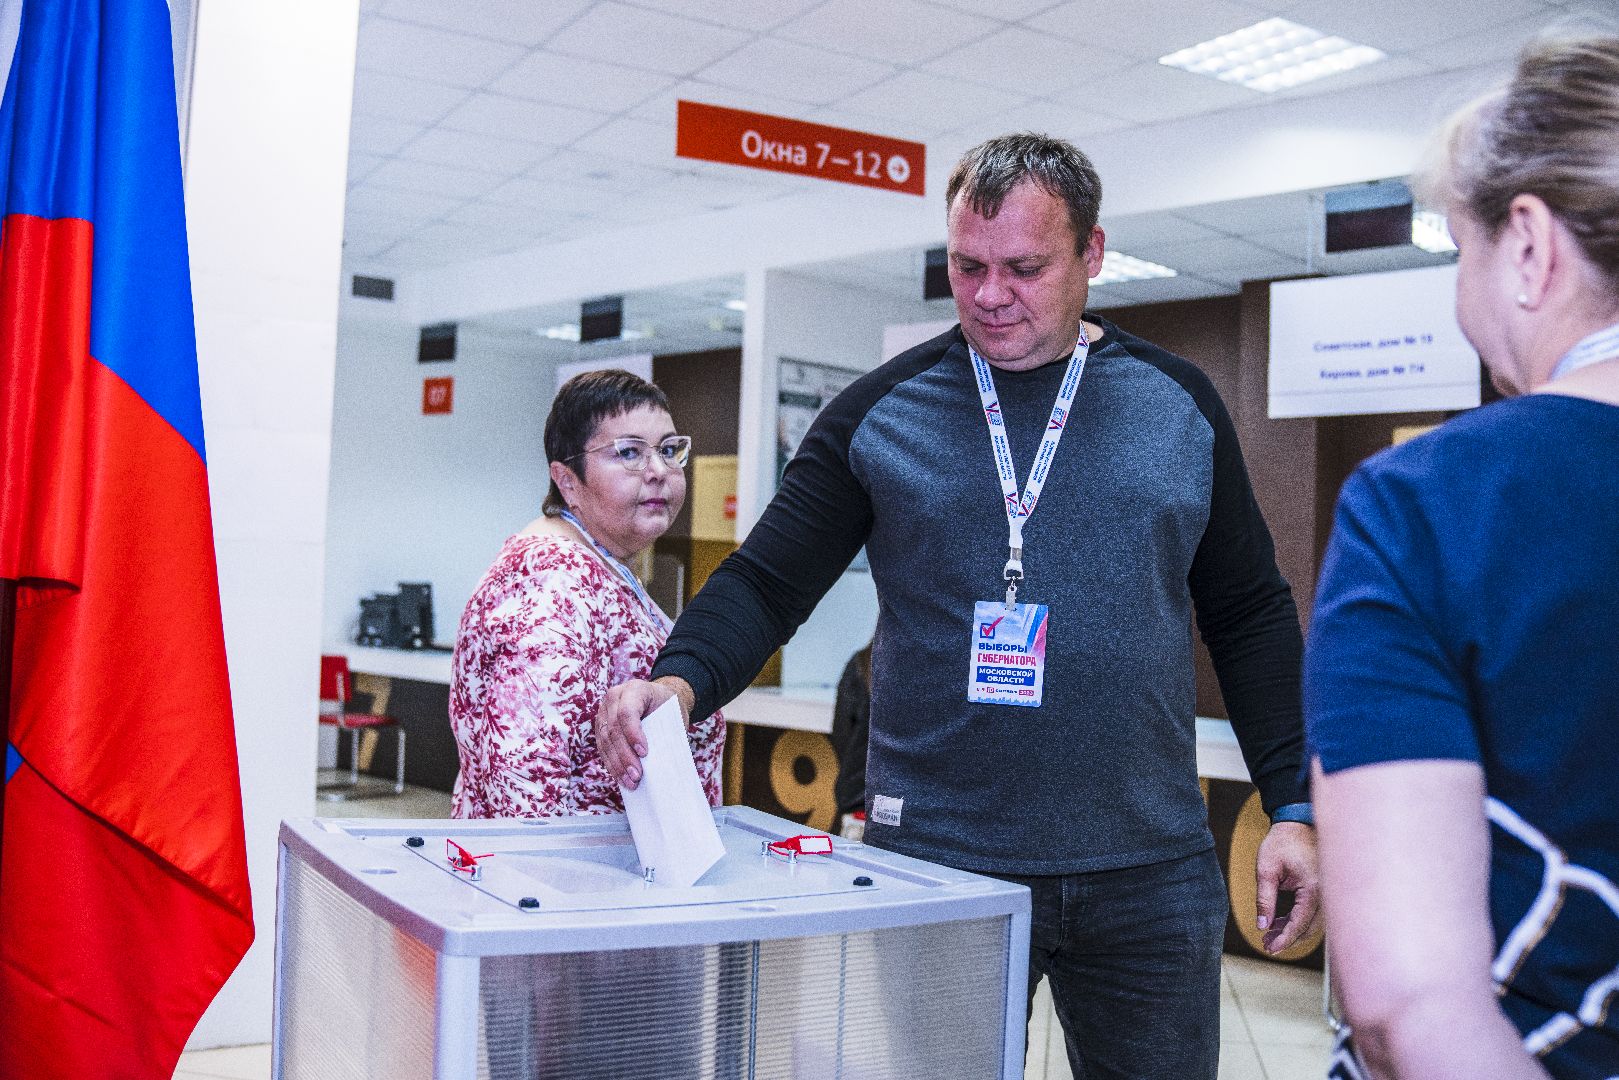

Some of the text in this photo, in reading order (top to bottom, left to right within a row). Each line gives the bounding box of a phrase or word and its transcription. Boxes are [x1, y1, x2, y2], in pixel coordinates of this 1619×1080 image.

[740, 129, 808, 167] Окна
[978, 642, 1028, 653] ВЫБОРЫ
[977, 653, 1037, 666] ГУБЕРНАТОРА
[978, 667, 1034, 677] МОСКОВСКОЙ
[986, 675, 1025, 684] ОБЛАСТИ
